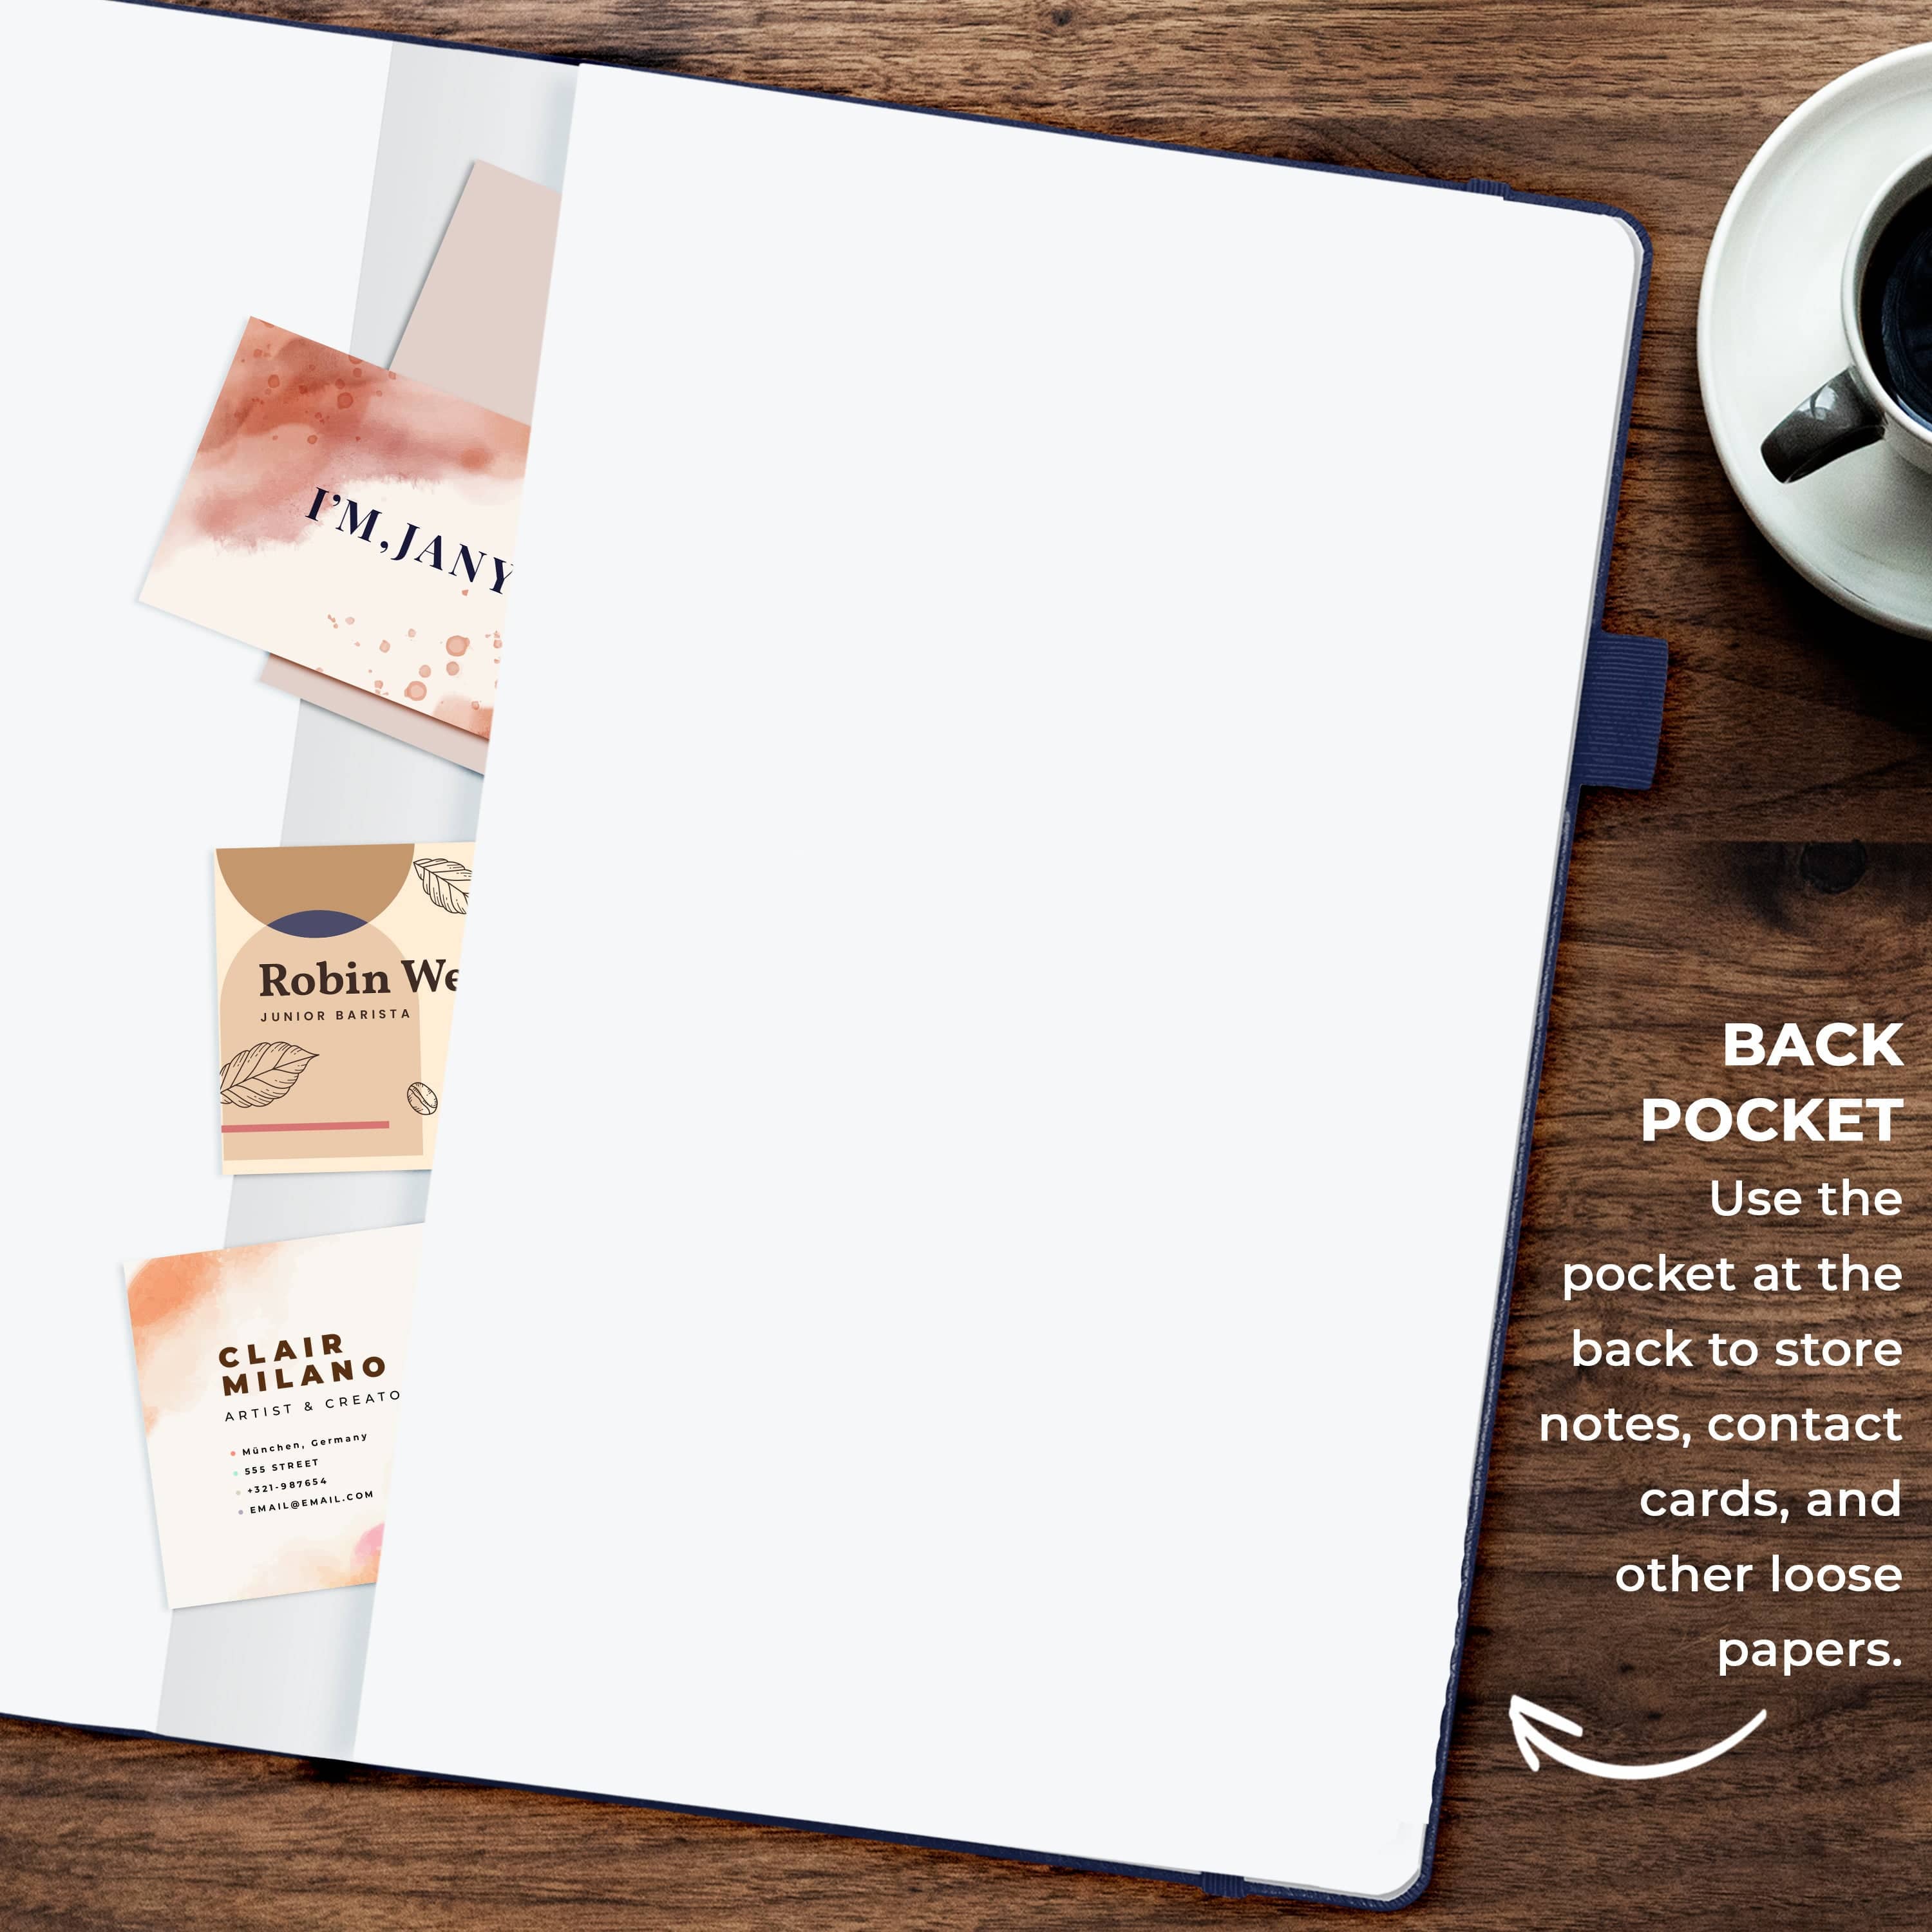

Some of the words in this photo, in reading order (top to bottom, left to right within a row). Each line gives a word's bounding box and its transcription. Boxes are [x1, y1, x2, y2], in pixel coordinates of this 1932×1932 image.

[259, 960, 391, 996] Robin
[260, 1011, 325, 1022] JUNIOR
[336, 1009, 410, 1020] BARISTA
[219, 1334, 343, 1368] CLAIR
[222, 1356, 385, 1396] MILANO
[225, 1404, 292, 1422] ARTIST
[304, 1401, 313, 1412] &
[325, 1390, 400, 1409] CREATO
[242, 1441, 305, 1456] München,
[311, 1433, 368, 1447] Germany
[245, 1466, 266, 1475] 555
[272, 1459, 319, 1472] STREET
[247, 1477, 327, 1493] +321-987654
[250, 1490, 374, 1514] EMAIL@EMAIL.COM
